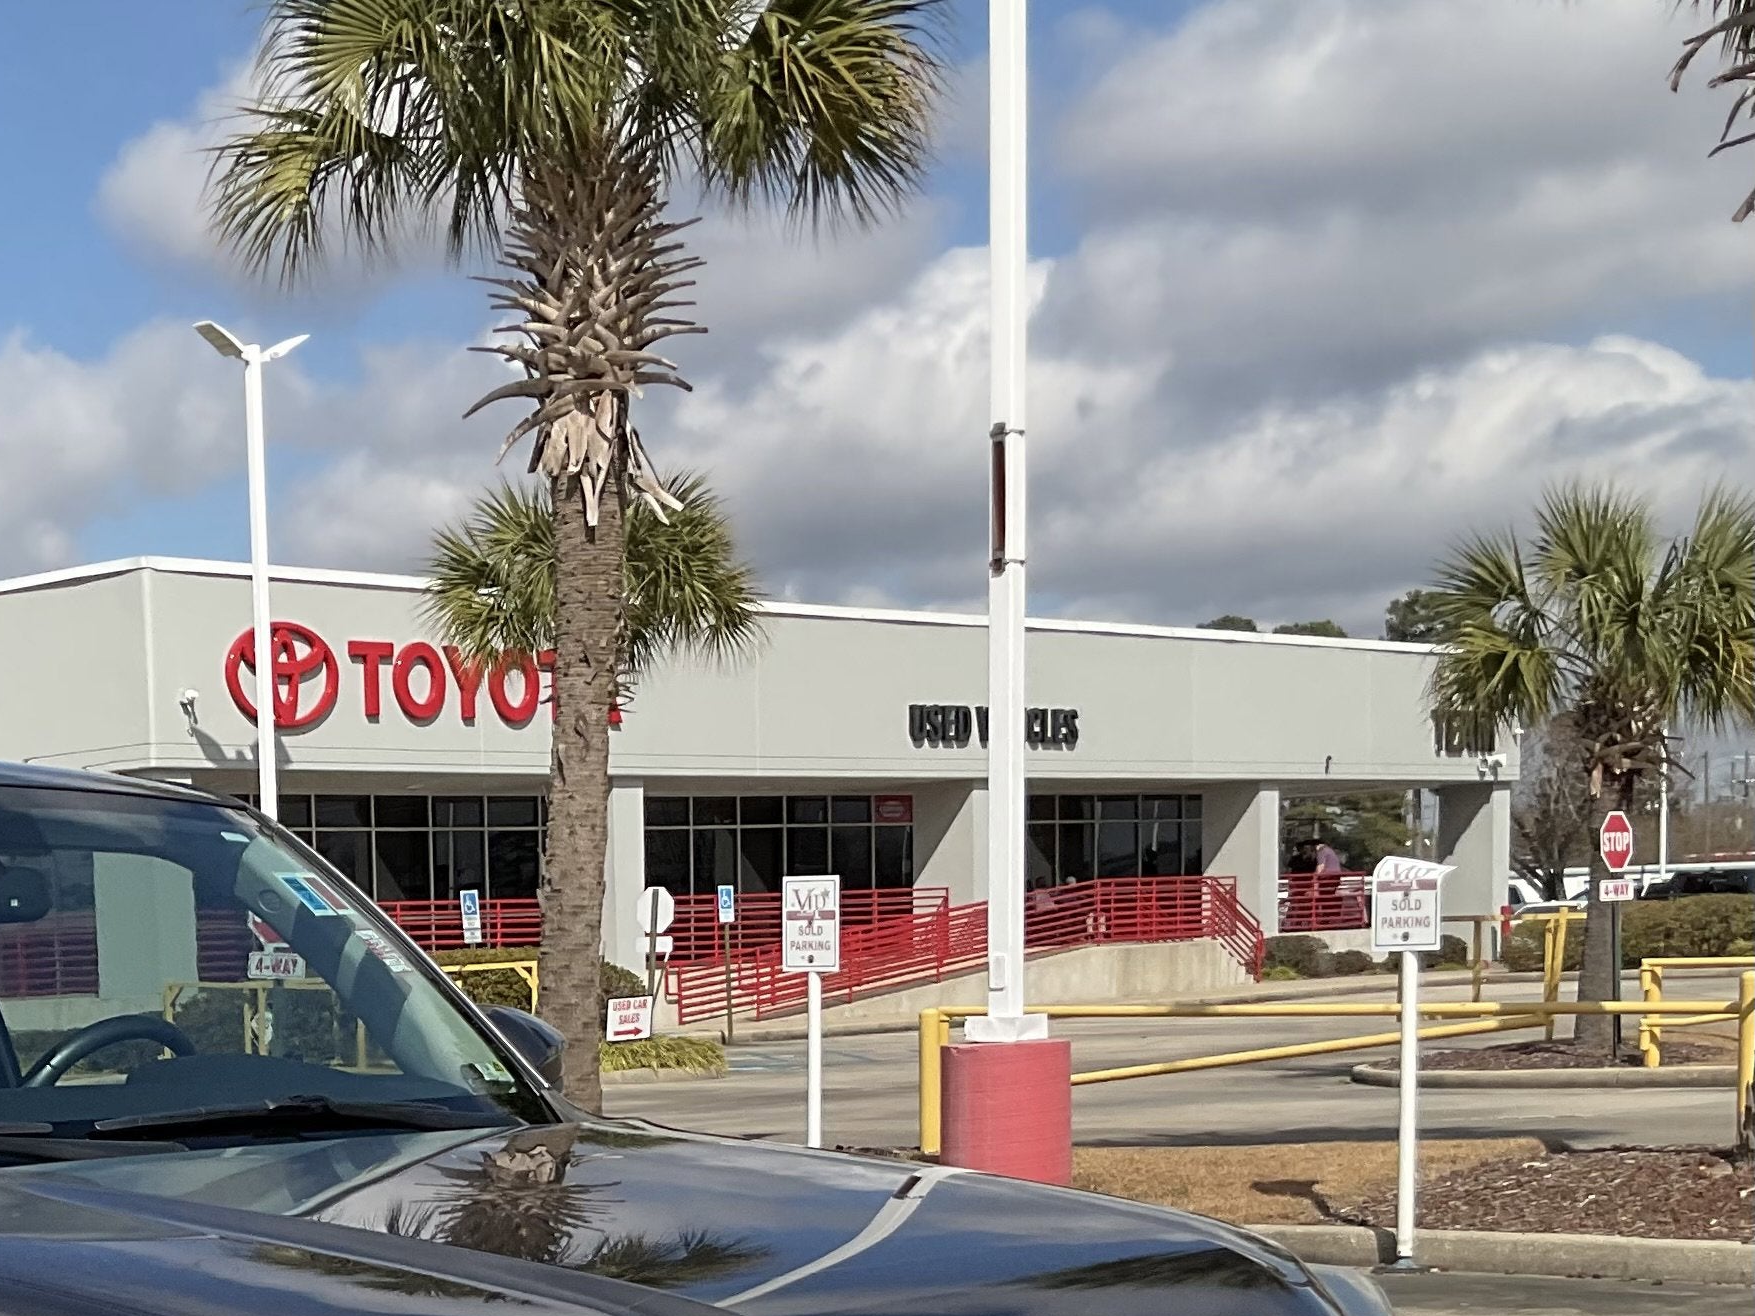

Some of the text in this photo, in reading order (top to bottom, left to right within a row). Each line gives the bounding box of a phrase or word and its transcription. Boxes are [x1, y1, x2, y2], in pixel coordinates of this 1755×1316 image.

[348, 642, 622, 725] TOYO
[908, 704, 1079, 750] USED VCLES
[1603, 832, 1630, 852] STOP
[1604, 883, 1630, 897] 4-WAY
[1391, 898, 1422, 911] SOLD
[1381, 916, 1431, 929] PARKING
[798, 925, 824, 936] SOLD
[790, 941, 832, 951] PARKING
[255, 958, 298, 975] 4-WAY
[613, 999, 648, 1011] USED CAR
[619, 1013, 640, 1025] SALES
